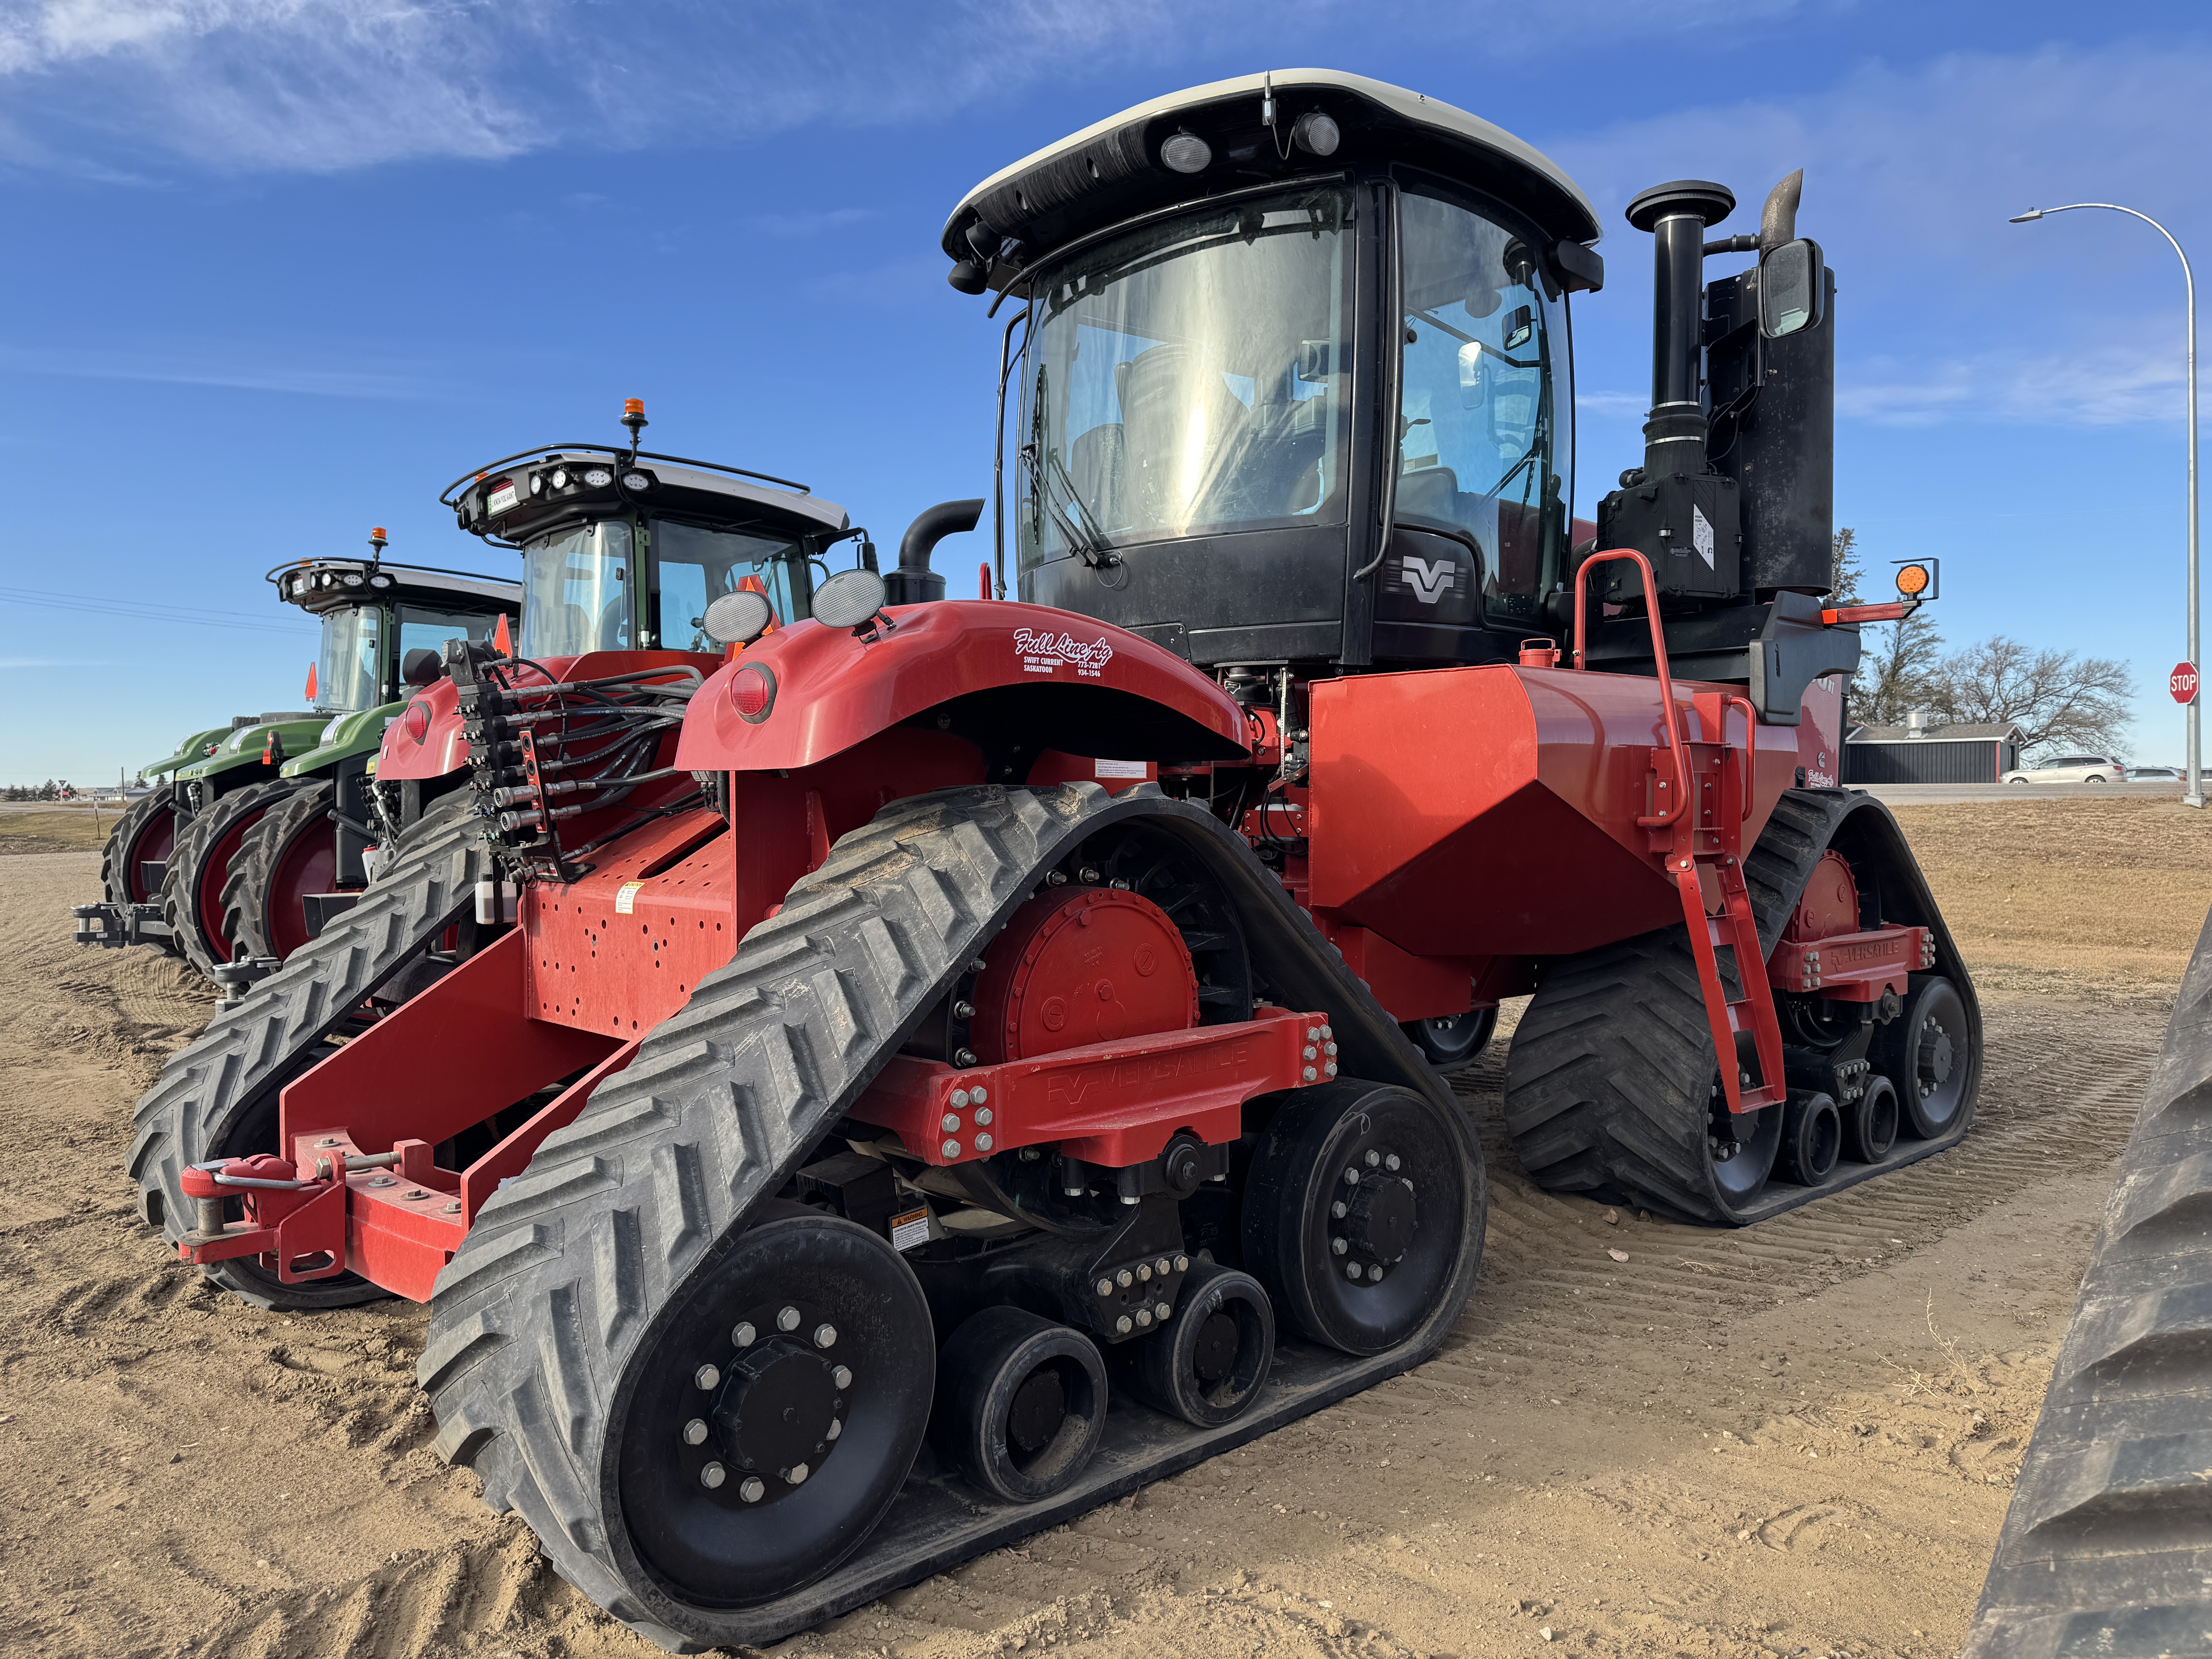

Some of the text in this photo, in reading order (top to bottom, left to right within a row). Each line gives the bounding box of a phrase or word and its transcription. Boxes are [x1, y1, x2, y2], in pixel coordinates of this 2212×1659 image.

[1013, 628, 1113, 666] Full Line Ag
[1024, 656, 1063, 666] SWIFT CURRENT
[1024, 665, 1053, 673] SASKATOON
[1077, 668, 1101, 677] 934-1546
[2171, 674, 2196, 692] STOP
[1848, 940, 1899, 962] VERSATILE
[1098, 1041, 1249, 1089] VERSATILE
[903, 1212, 923, 1222] WARNING
